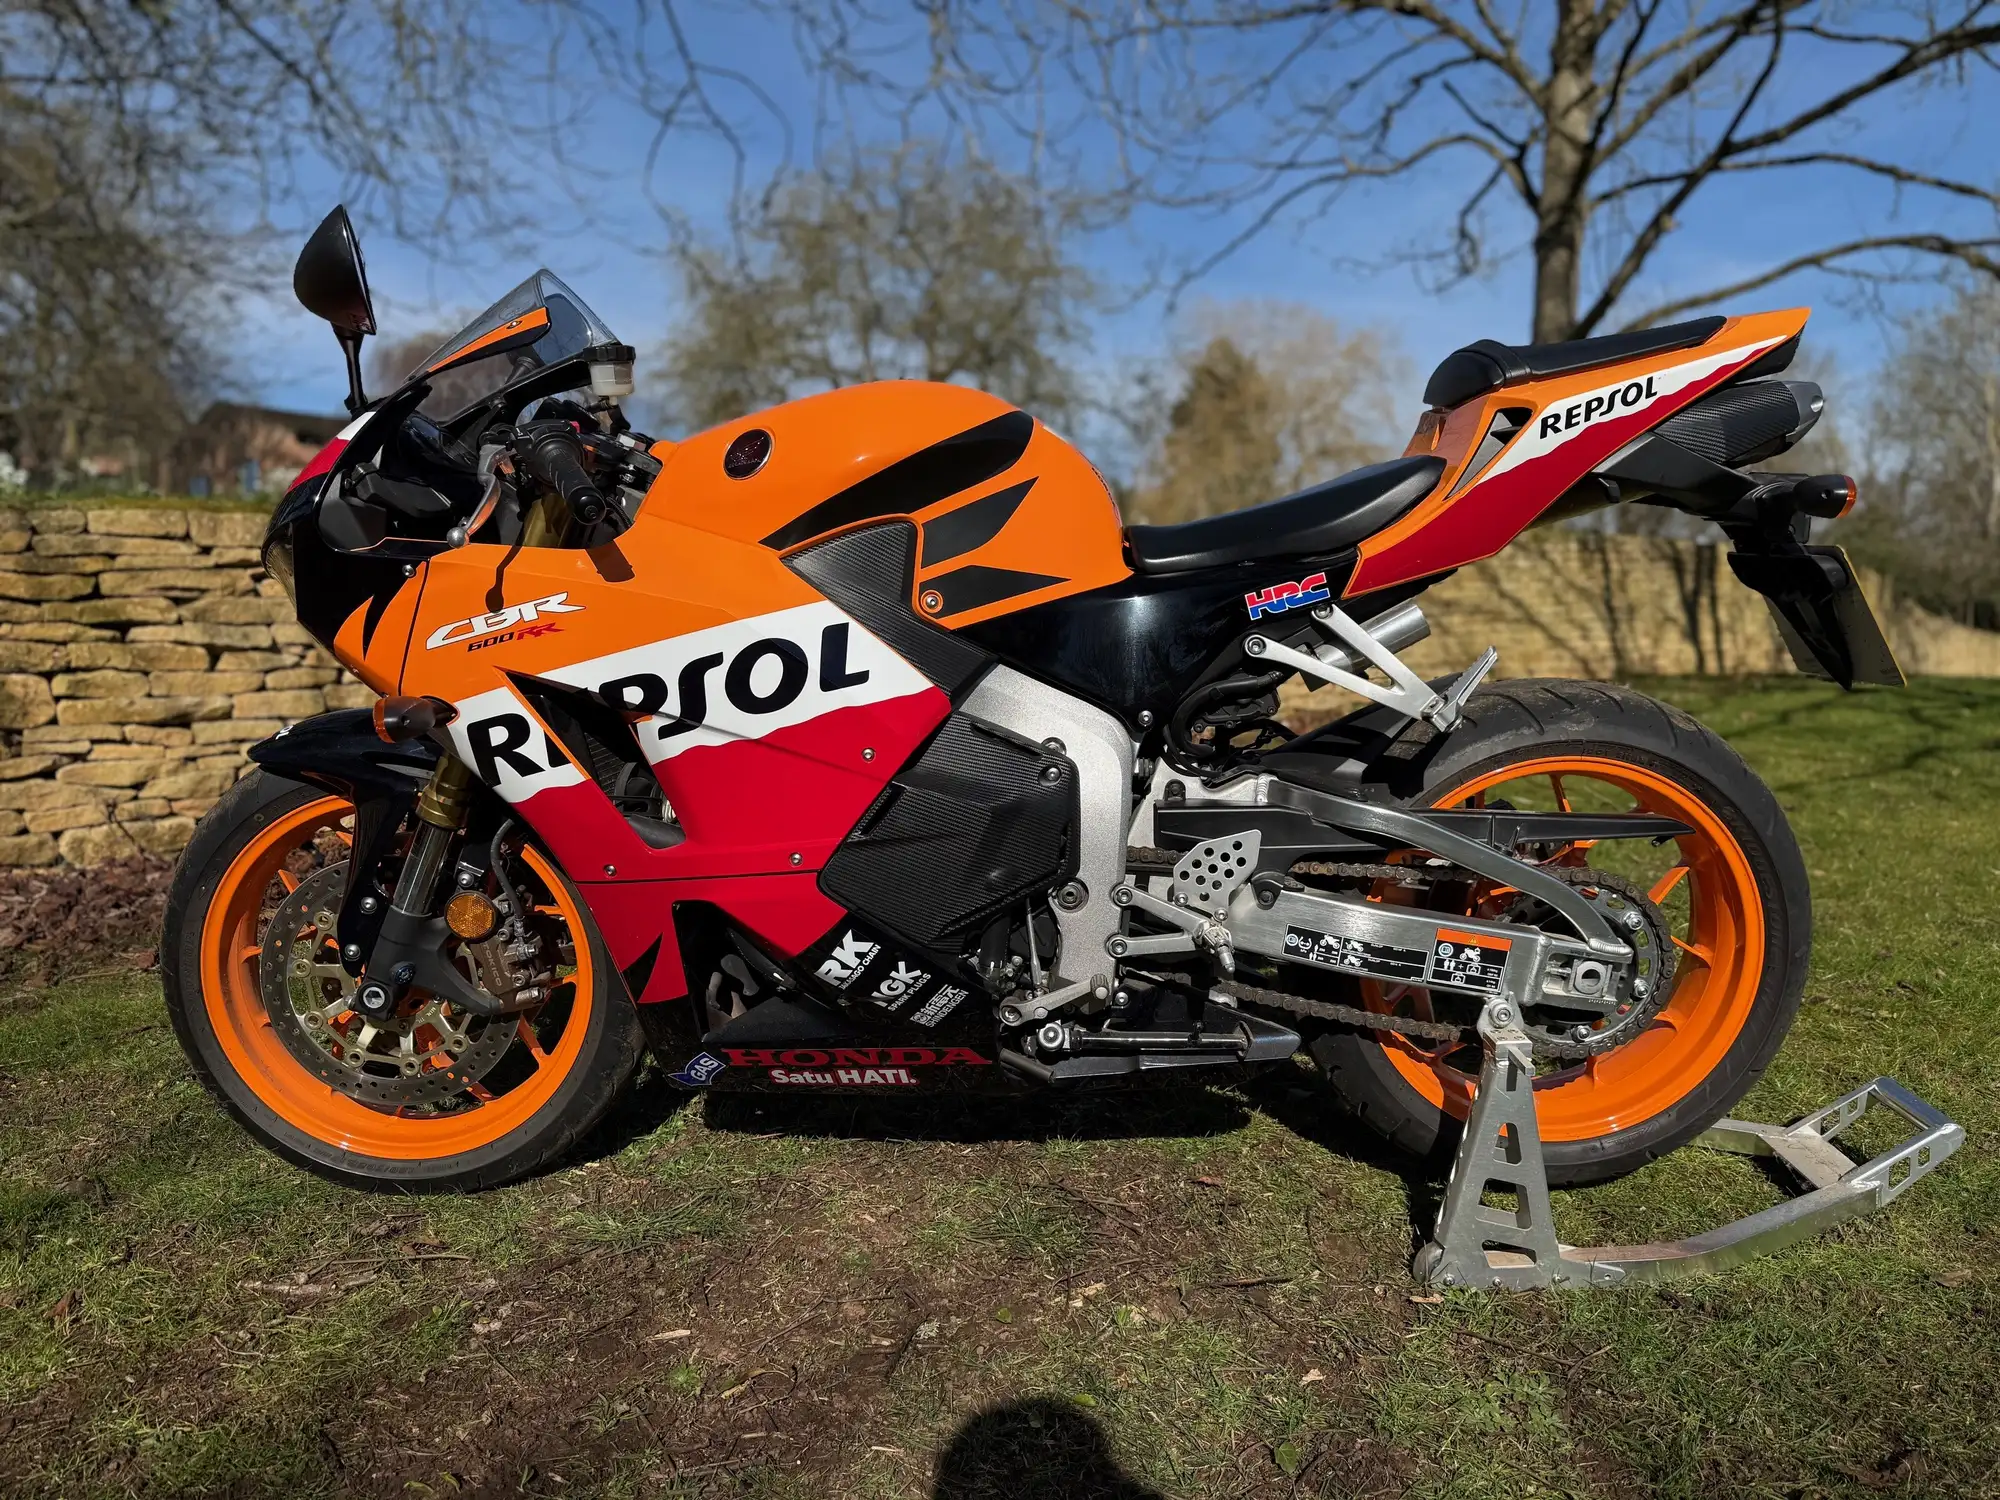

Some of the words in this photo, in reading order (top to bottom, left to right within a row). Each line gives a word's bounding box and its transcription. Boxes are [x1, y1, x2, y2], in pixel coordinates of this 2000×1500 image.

[1540, 376, 1657, 439] REPSOL
[1245, 572, 1330, 620] HRC
[426, 591, 586, 650] CBR
[467, 632, 514, 652] 600
[516, 622, 565, 641] RR
[467, 622, 870, 785] RPSOL
[483, 942, 502, 986] TOKICO
[814, 929, 874, 987] RK
[862, 943, 881, 966] CHAIN
[888, 993, 909, 1012] SPARK
[907, 973, 931, 996] PLUGS
[926, 989, 969, 1028] SHINDENGEN
[690, 1057, 719, 1082] GAS
[721, 1048, 992, 1066] HONDA
[771, 1069, 833, 1084] Satu
[838, 1068, 917, 1085] HATI.
